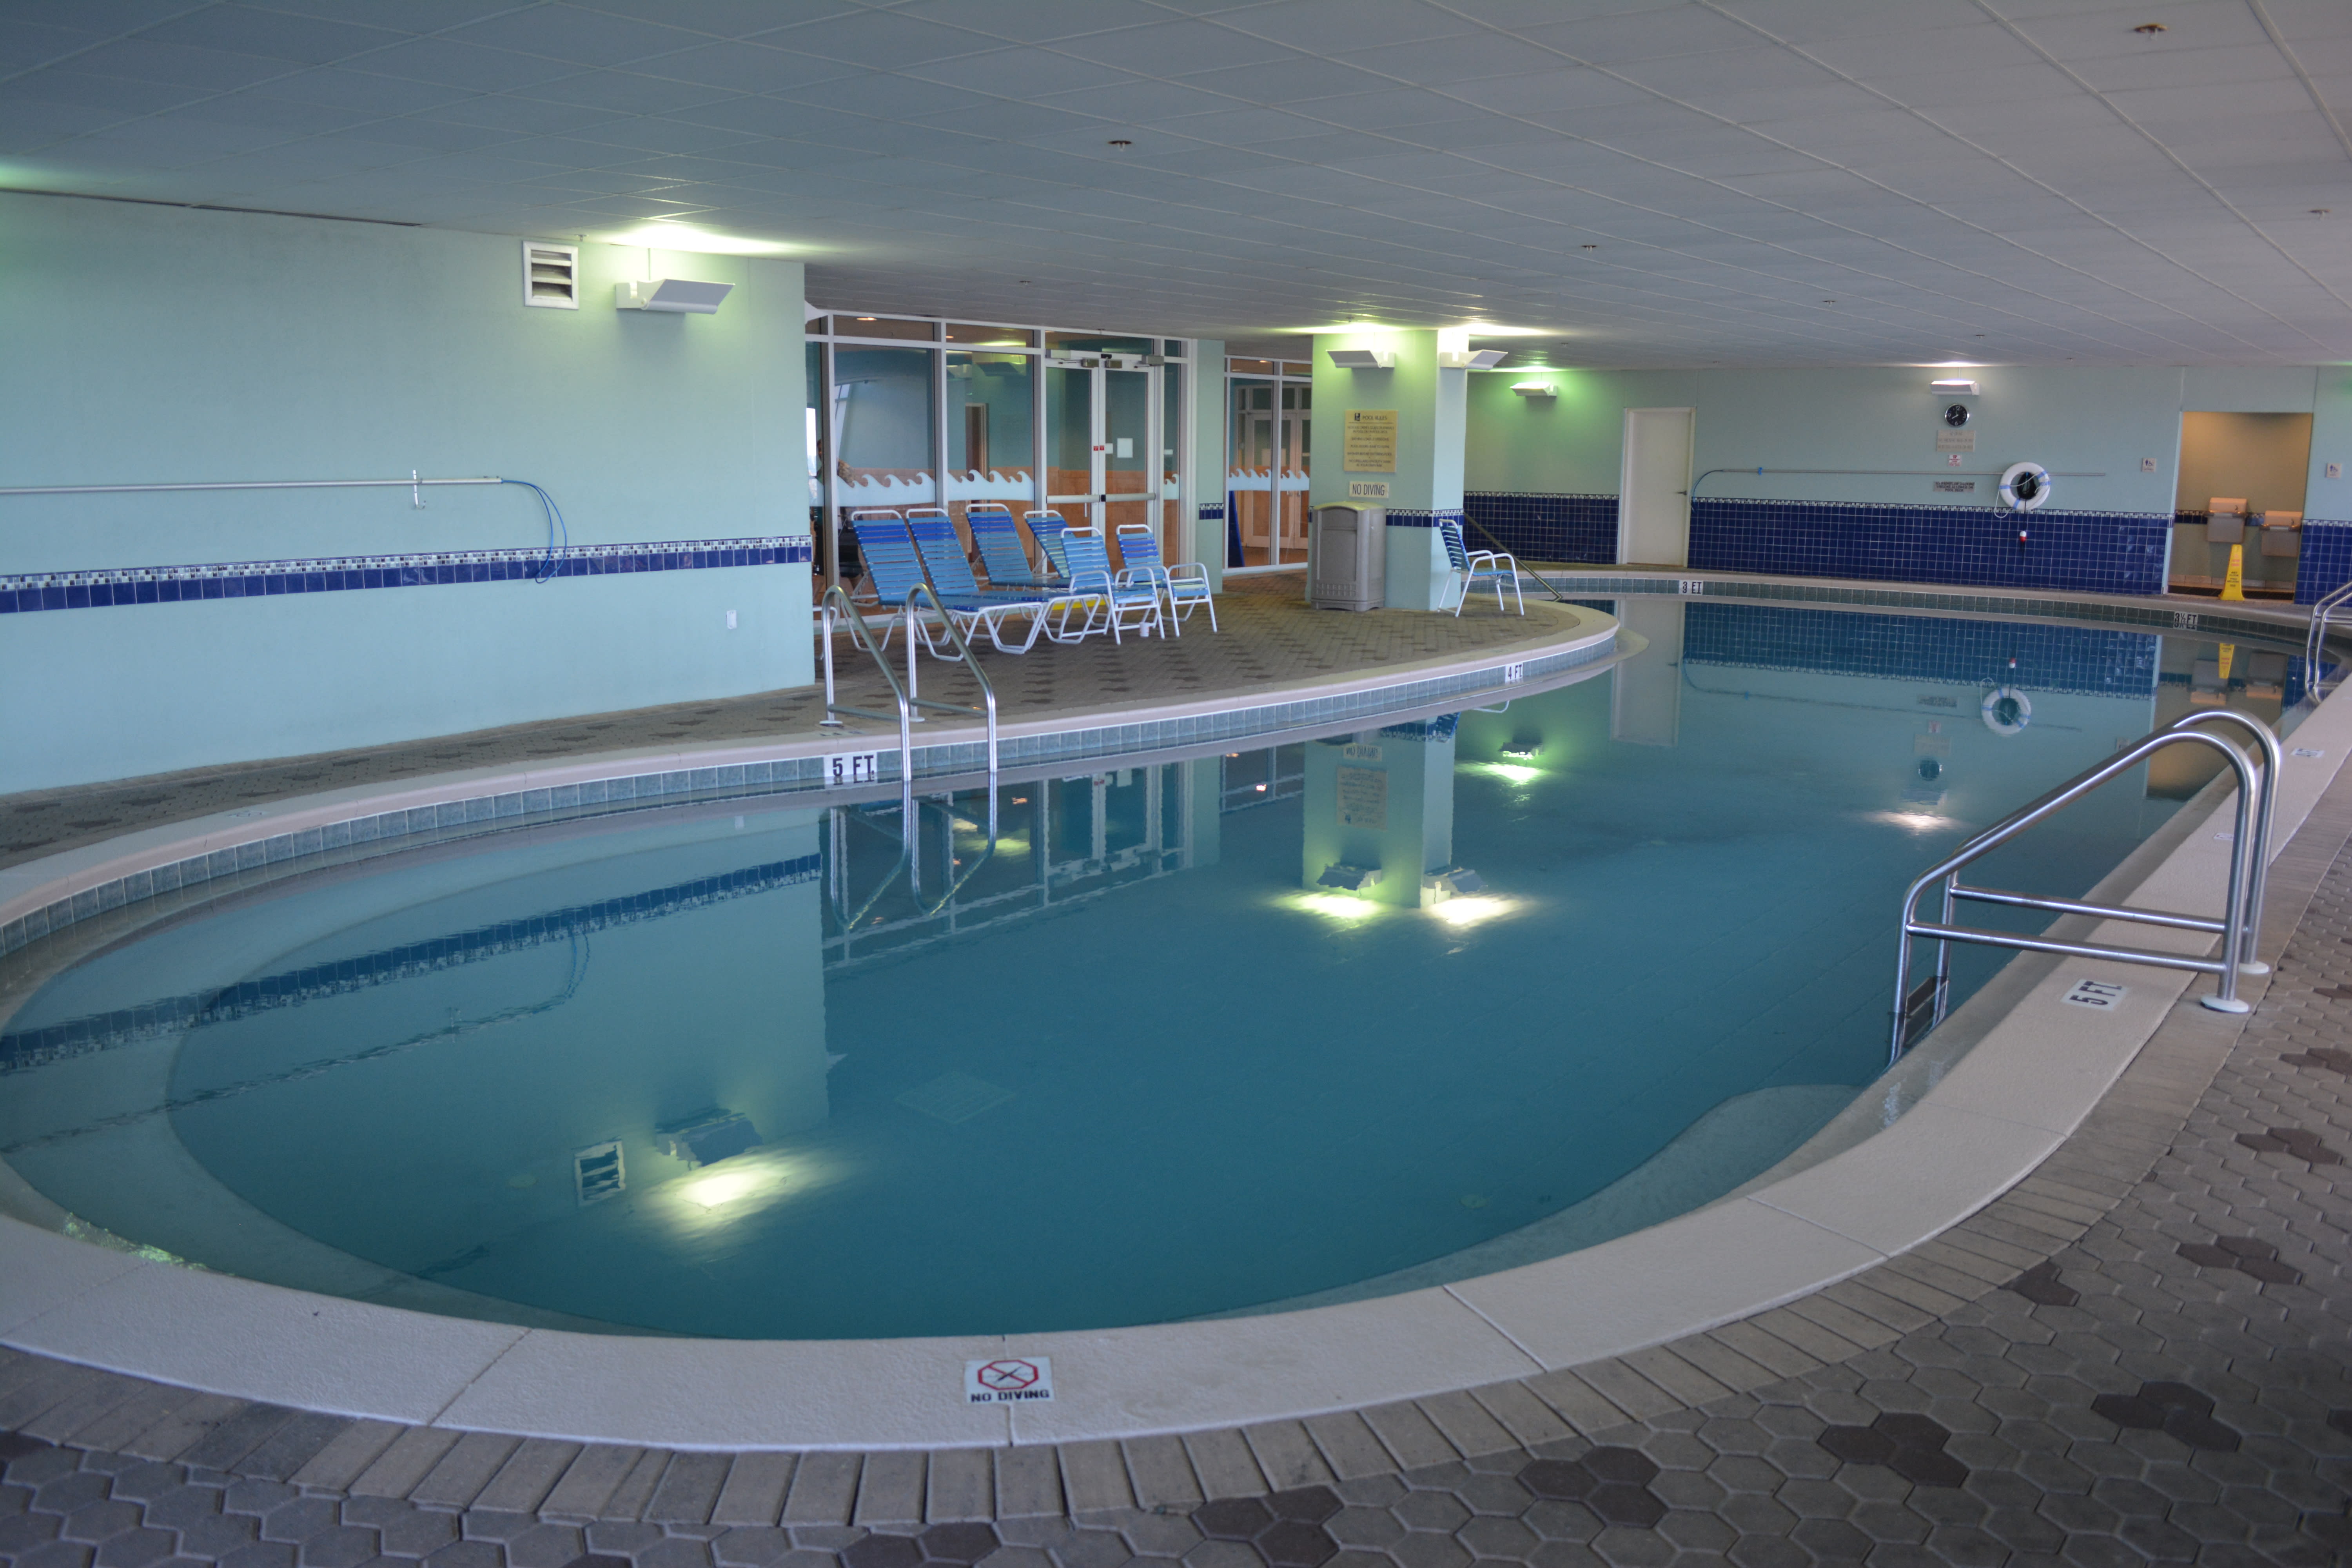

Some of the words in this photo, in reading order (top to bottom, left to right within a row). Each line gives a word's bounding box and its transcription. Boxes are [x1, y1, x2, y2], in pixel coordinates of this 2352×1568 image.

[1352, 484, 1361, 495] NO
[1364, 484, 1385, 495] DIVING
[1683, 581, 1687, 590] 3
[1508, 666, 1512, 679] 4
[833, 757, 843, 776] 5
[2069, 995, 2108, 1005] 5
[971, 1392, 992, 1403] NO
[998, 1389, 1050, 1401] DIVING
